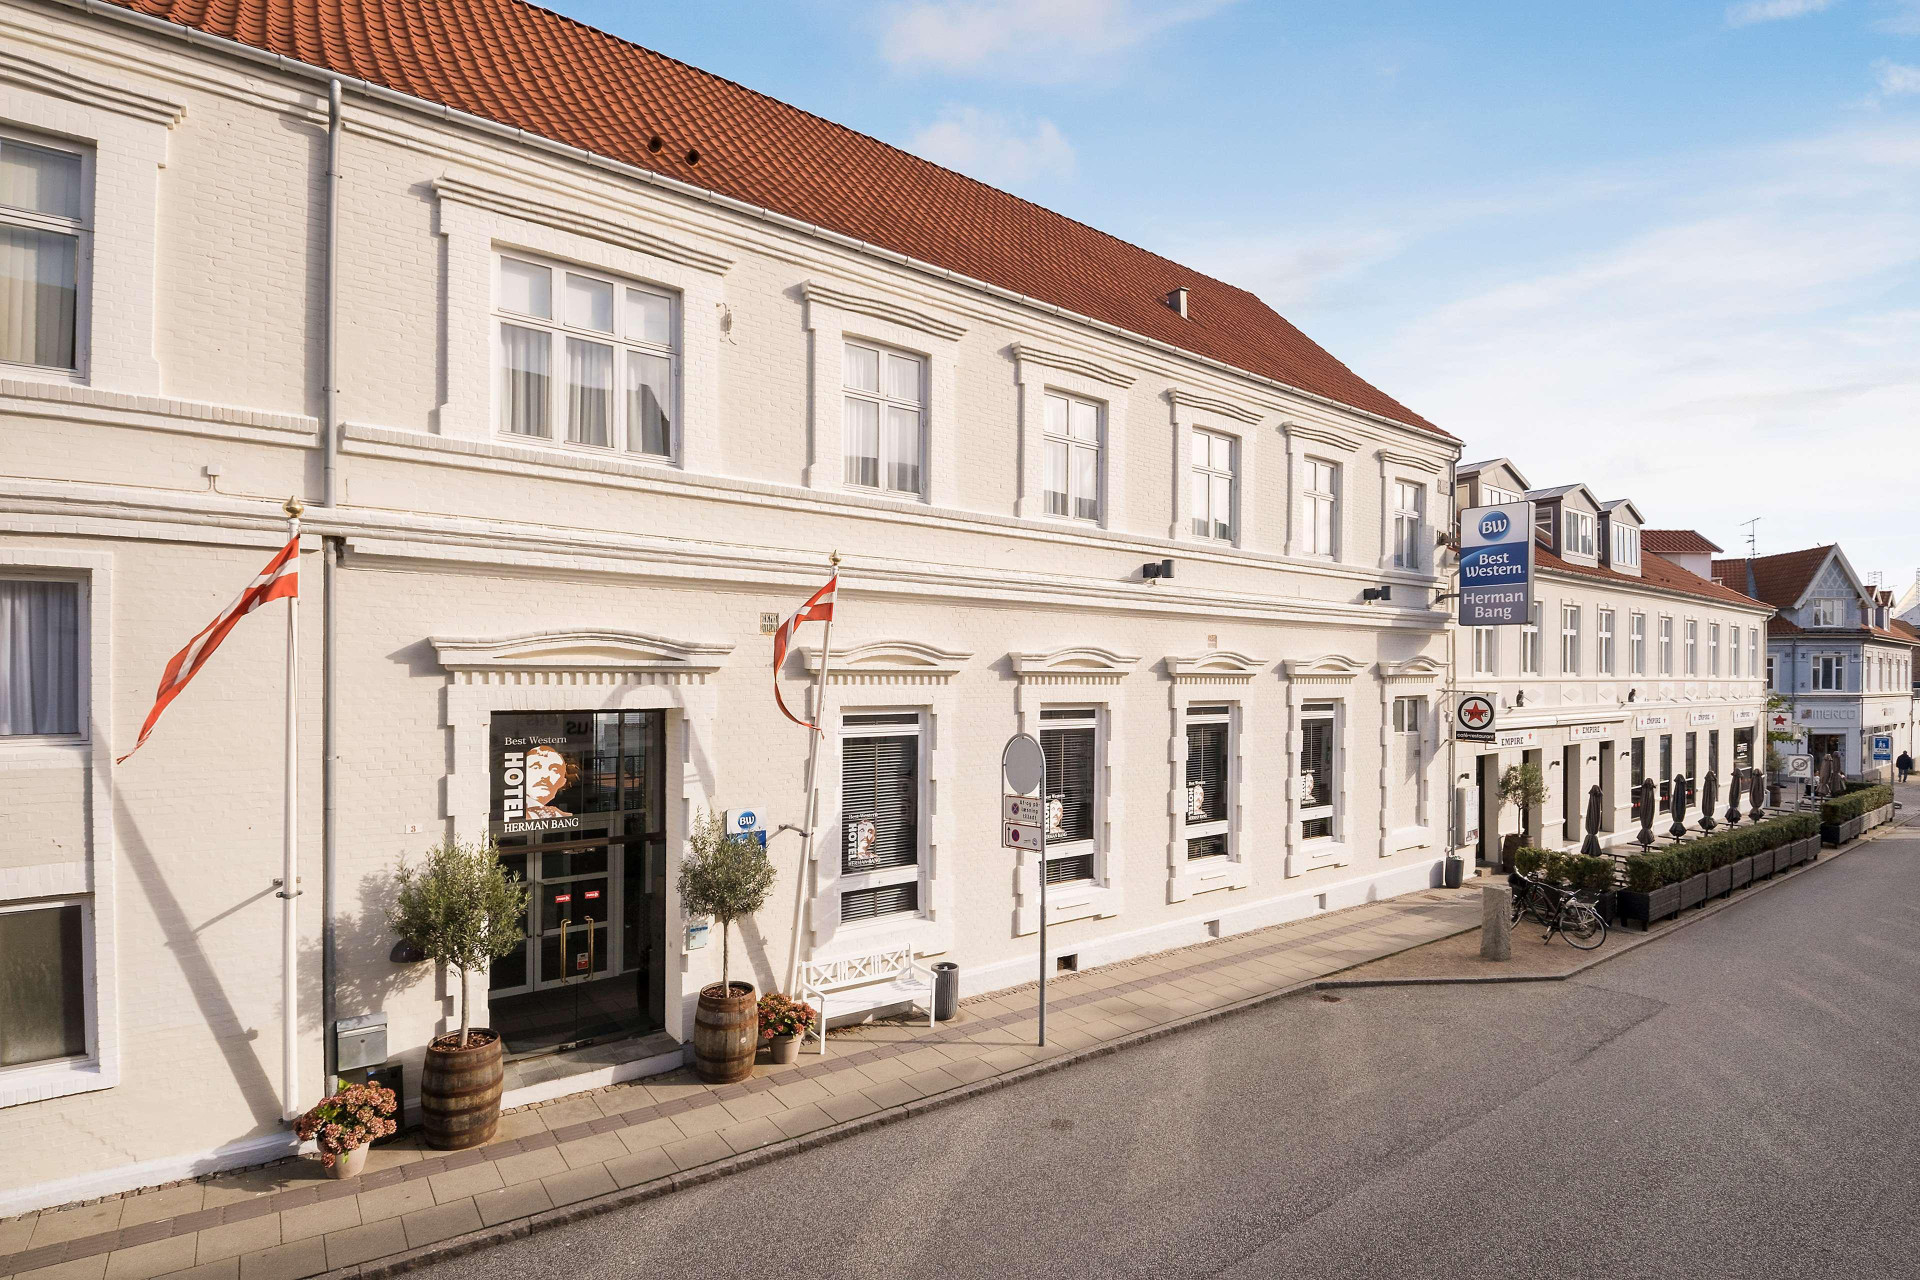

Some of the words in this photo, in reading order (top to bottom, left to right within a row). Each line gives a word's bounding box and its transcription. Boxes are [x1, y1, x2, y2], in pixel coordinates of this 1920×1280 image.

[1482, 519, 1507, 534] BW
[1479, 552, 1509, 565] Best
[1465, 564, 1522, 578] Western
[1463, 591, 1524, 605] Herman
[1475, 606, 1512, 620] Bang
[1582, 726, 1600, 734] EMPIRE
[504, 736, 527, 746] Best
[529, 735, 567, 745] Western
[1501, 737, 1524, 746] EMPIRE
[504, 752, 524, 822] HOTEL
[504, 819, 549, 833] HERMAN
[550, 817, 579, 829] BANG
[740, 816, 754, 826] BW
[848, 823, 857, 861] HOTEL
